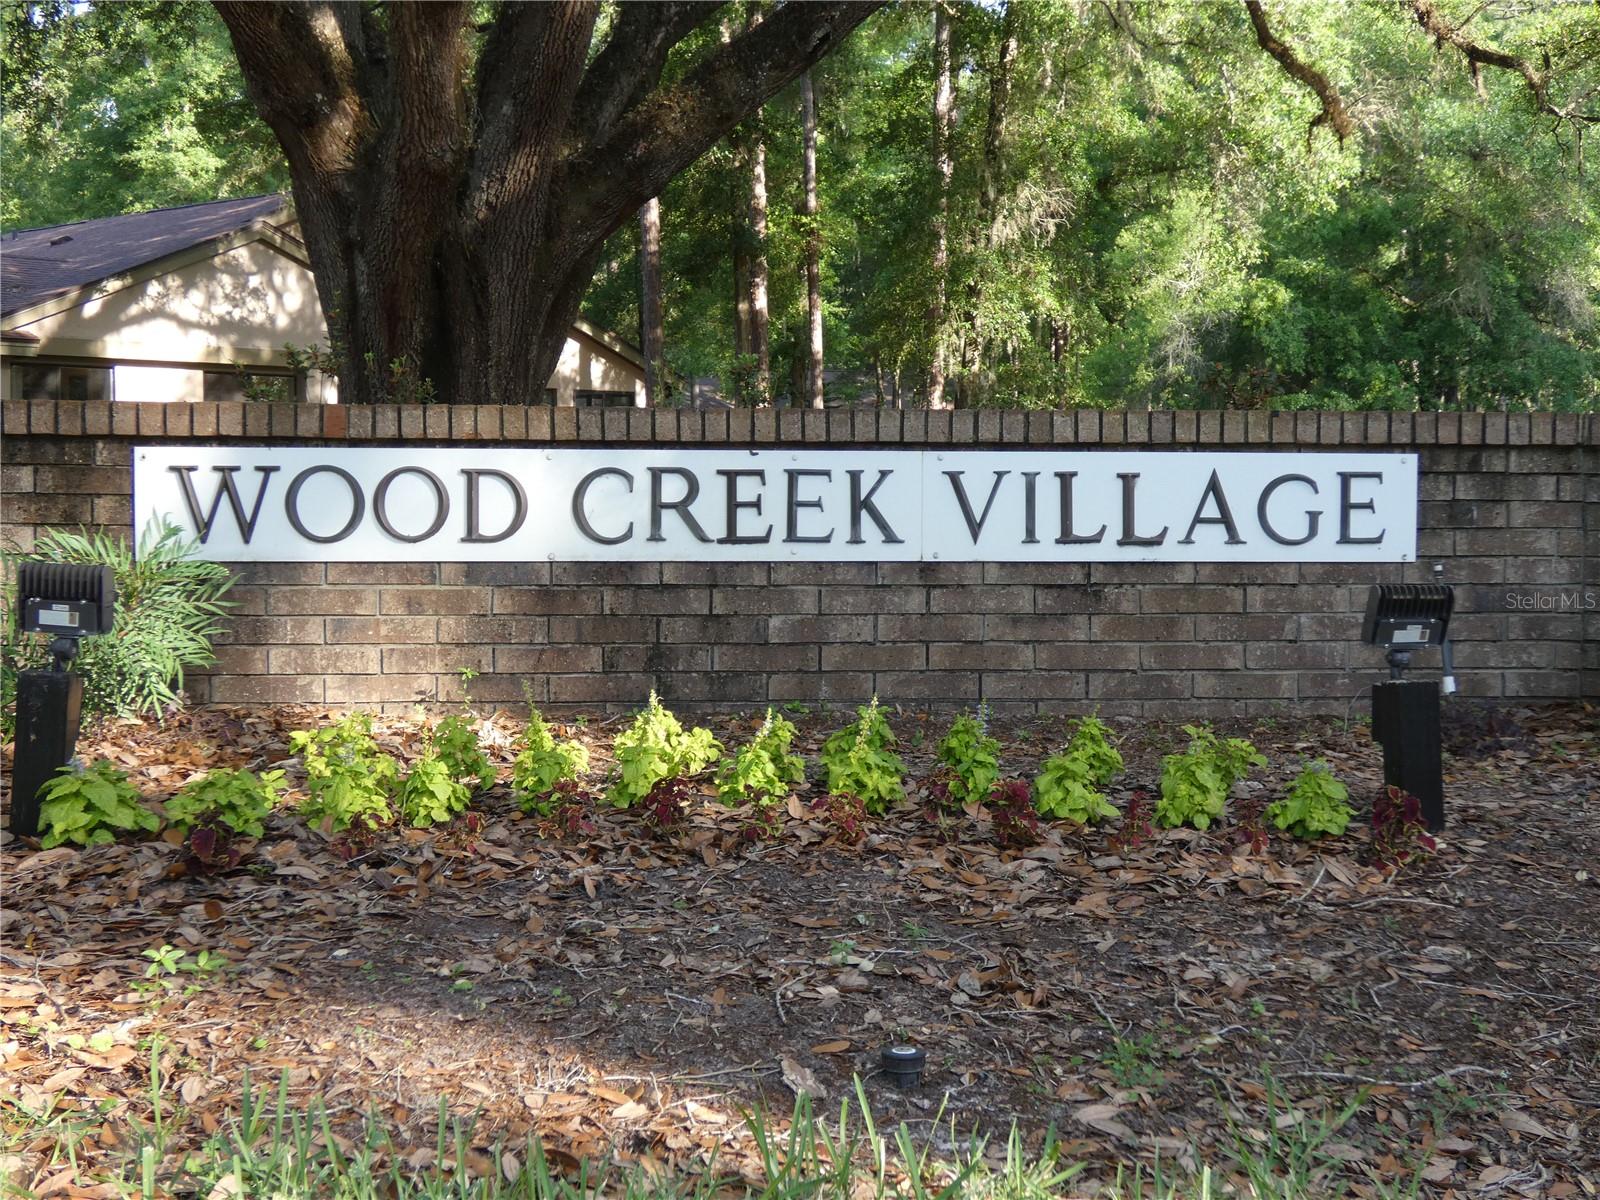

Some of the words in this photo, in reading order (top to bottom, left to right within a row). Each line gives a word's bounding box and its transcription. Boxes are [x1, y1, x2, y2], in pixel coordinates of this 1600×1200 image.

[168, 464, 529, 545] WOOD
[571, 466, 906, 546] CREEK
[941, 467, 1387, 547] VILLAGE
